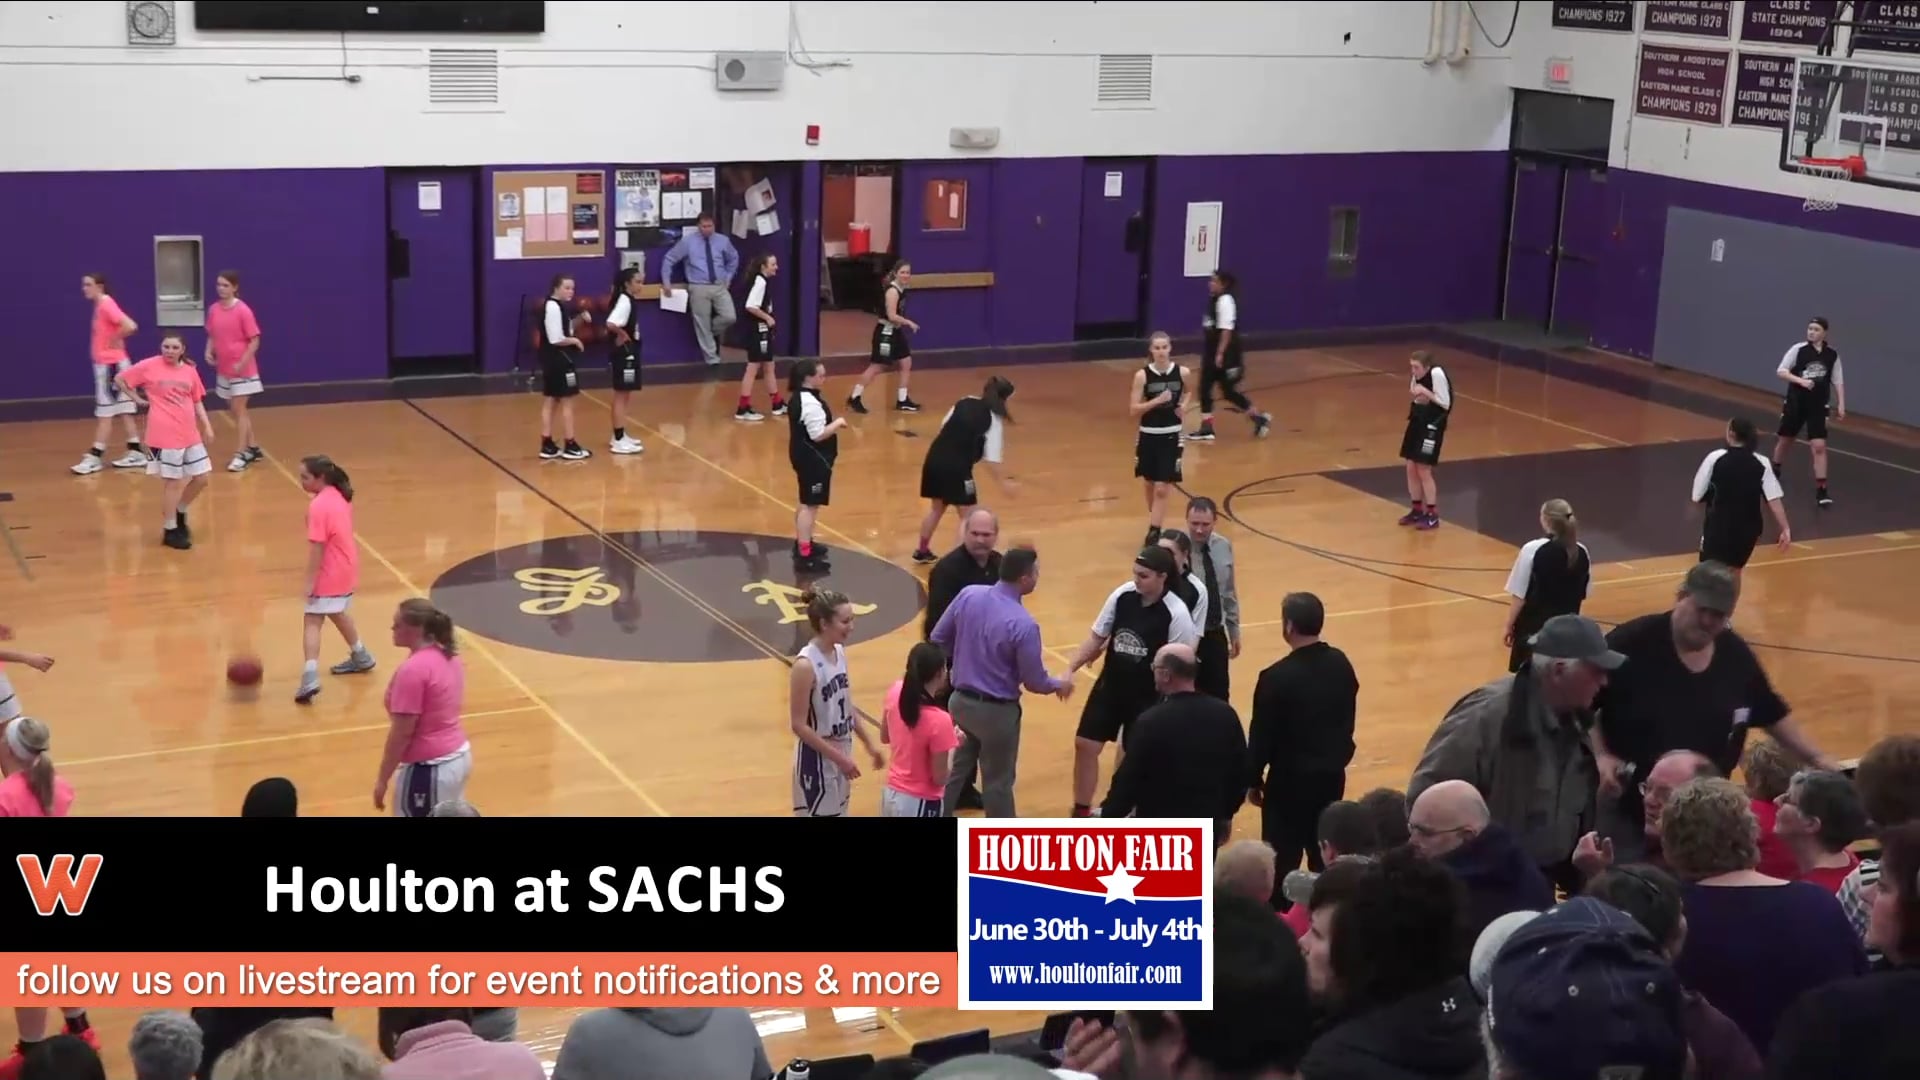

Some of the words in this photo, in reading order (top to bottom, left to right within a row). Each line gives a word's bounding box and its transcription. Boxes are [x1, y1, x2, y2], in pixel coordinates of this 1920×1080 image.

[1559, 8, 1603, 21] CHAMPIONS
[1605, 10, 1626, 23] 1977
[1651, 11, 1697, 26] CHAMPIONS
[1700, 14, 1722, 28] 1978
[1751, 12, 1776, 24] STATE
[1780, 14, 1827, 27] CHAMPIONS
[1769, 29, 1803, 38] 1984
[1643, 51, 1679, 62] SOUTHERN
[1744, 58, 1780, 72] SOUTHERN
[1657, 68, 1674, 76] HIGH
[1678, 69, 1706, 80] SCHOOL
[1759, 76, 1775, 87] HIGH
[1640, 80, 1670, 91] EASTERN
[1671, 84, 1690, 93] MAINE
[1692, 86, 1715, 96] CLASS
[1738, 90, 1767, 102] EASTERN
[1771, 92, 1791, 105] MAINE
[1641, 95, 1690, 112] CHAMPIONS
[1694, 102, 1717, 116] 1979
[1738, 106, 1790, 122] CHAMPIONS
